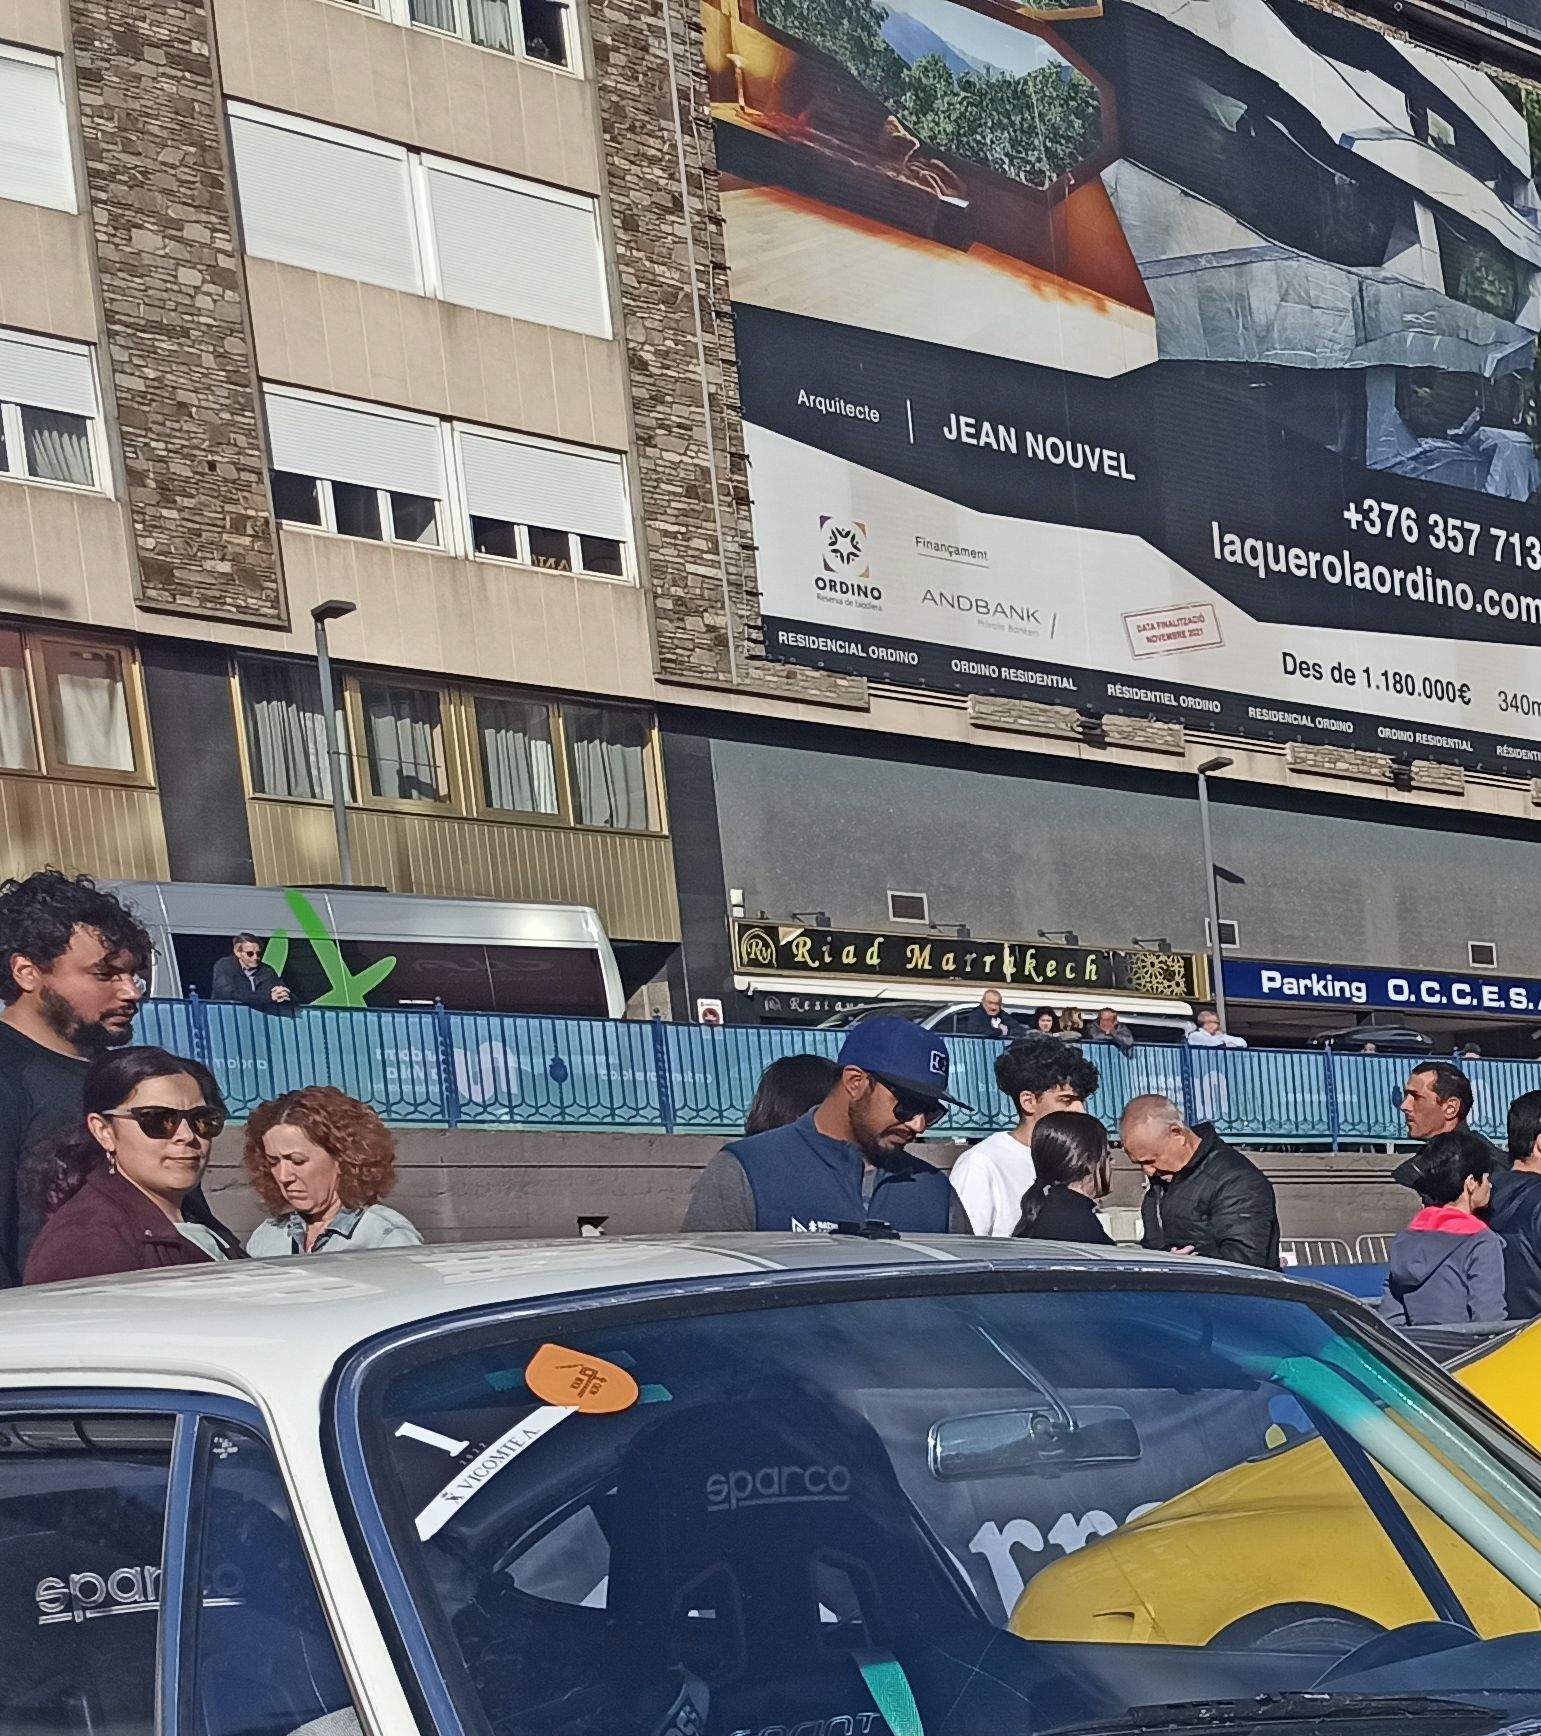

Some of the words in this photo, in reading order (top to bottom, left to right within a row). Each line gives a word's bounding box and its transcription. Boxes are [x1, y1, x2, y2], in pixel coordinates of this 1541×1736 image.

[797, 388, 881, 424] Arquitecte
[943, 413, 1018, 455] JEAN
[1025, 431, 1137, 482] NOUVEL
[1343, 497, 1420, 545] +376
[1429, 512, 1482, 558] 357
[915, 536, 989, 562] Finançament
[814, 575, 882, 602] ORDINO
[921, 588, 1043, 626] ANDBANK
[1136, 622, 1157, 634] DATA
[1146, 629, 1188, 644] NOVEMBRE
[777, 629, 868, 660] RESIDENCIAL
[868, 645, 920, 667] ORDINO
[951, 658, 999, 680] ORDINO
[1000, 666, 1079, 693] RESIDENTIAL
[1282, 650, 1325, 681] Des
[1330, 659, 1357, 687] de
[1362, 666, 1472, 707] 1.180.000€
[1106, 682, 1179, 710] RÉSIDENTIEL
[1179, 694, 1223, 714] ORDINO
[1248, 706, 1315, 730] RESIDENCIAL
[1315, 716, 1355, 734] ORDINO
[1377, 725, 1415, 744] ORDINO
[1414, 731, 1475, 753] RESIDENTIAL
[792, 935, 886, 969] Riad
[1260, 969, 1368, 1003] Parking
[457, 1435, 523, 1491] VICOMTE
[705, 1463, 851, 1510] sparco
[36, 1564, 245, 1623] sparo
